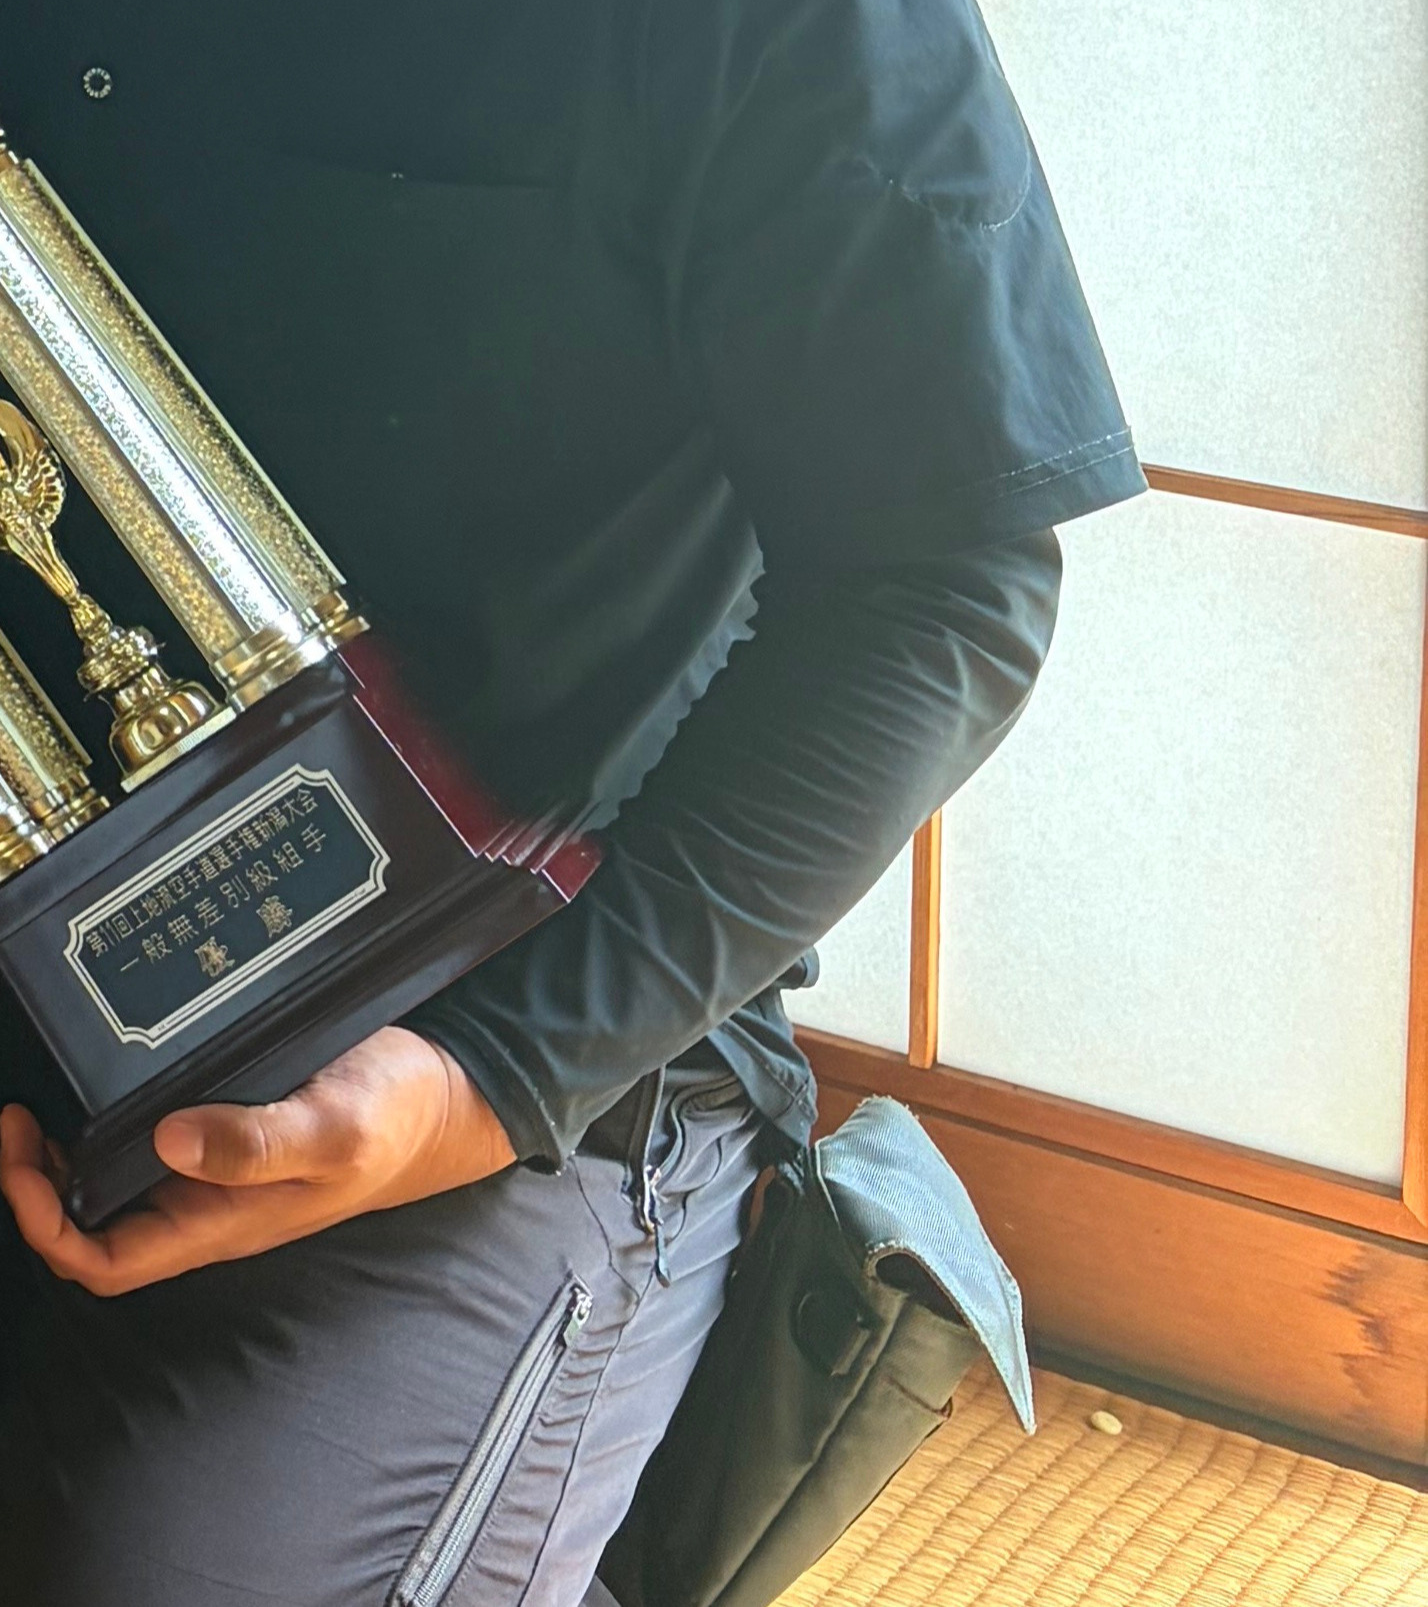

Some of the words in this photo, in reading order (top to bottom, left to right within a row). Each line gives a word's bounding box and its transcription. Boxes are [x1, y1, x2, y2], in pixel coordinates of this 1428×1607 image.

[85, 787, 320, 958] 第11回上地流空手道選手権新潟大会
[120, 822, 328, 973] 一般無差別級組手
[193, 894, 294, 978] 優勝
